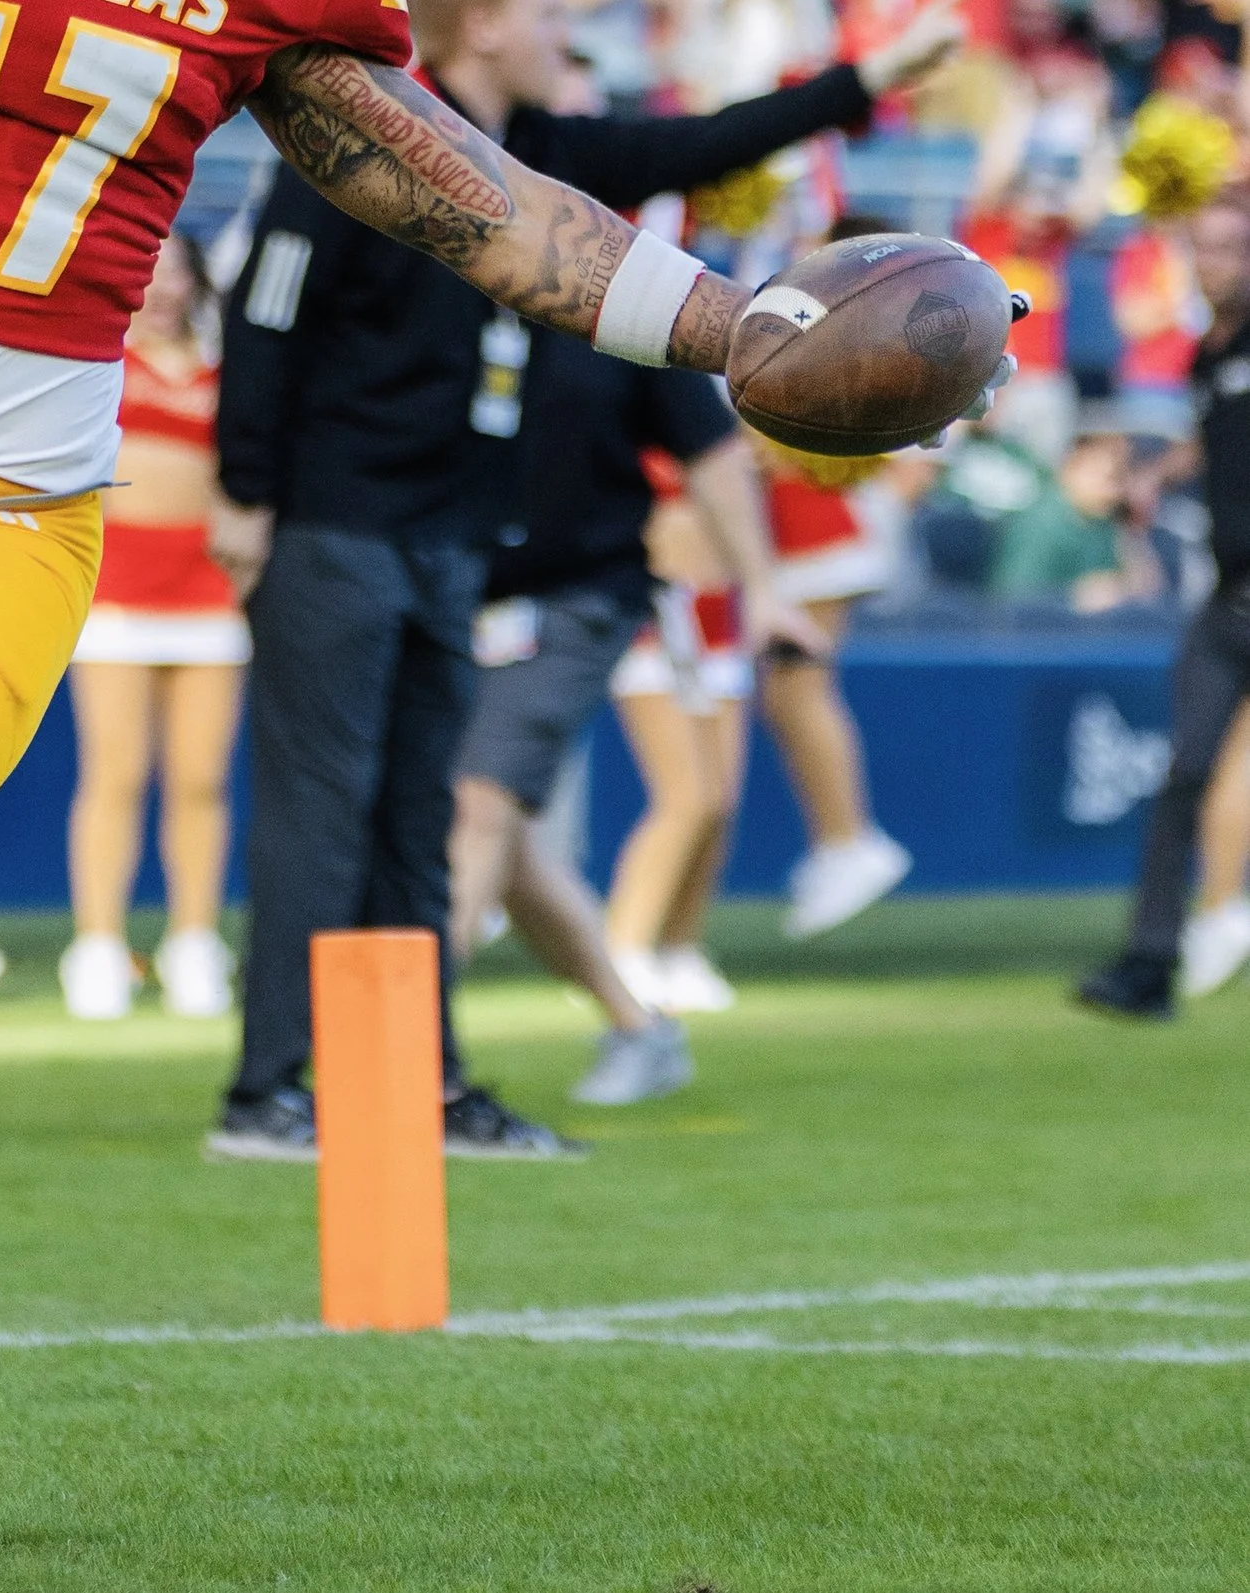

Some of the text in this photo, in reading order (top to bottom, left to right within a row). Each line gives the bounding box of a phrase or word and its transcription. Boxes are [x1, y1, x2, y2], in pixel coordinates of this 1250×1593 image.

[297, 56, 415, 144] DETERMINED
[417, 151, 508, 218] SUCCEED
[585, 232, 623, 309] FUTURE
[862, 244, 903, 263] NCAA
